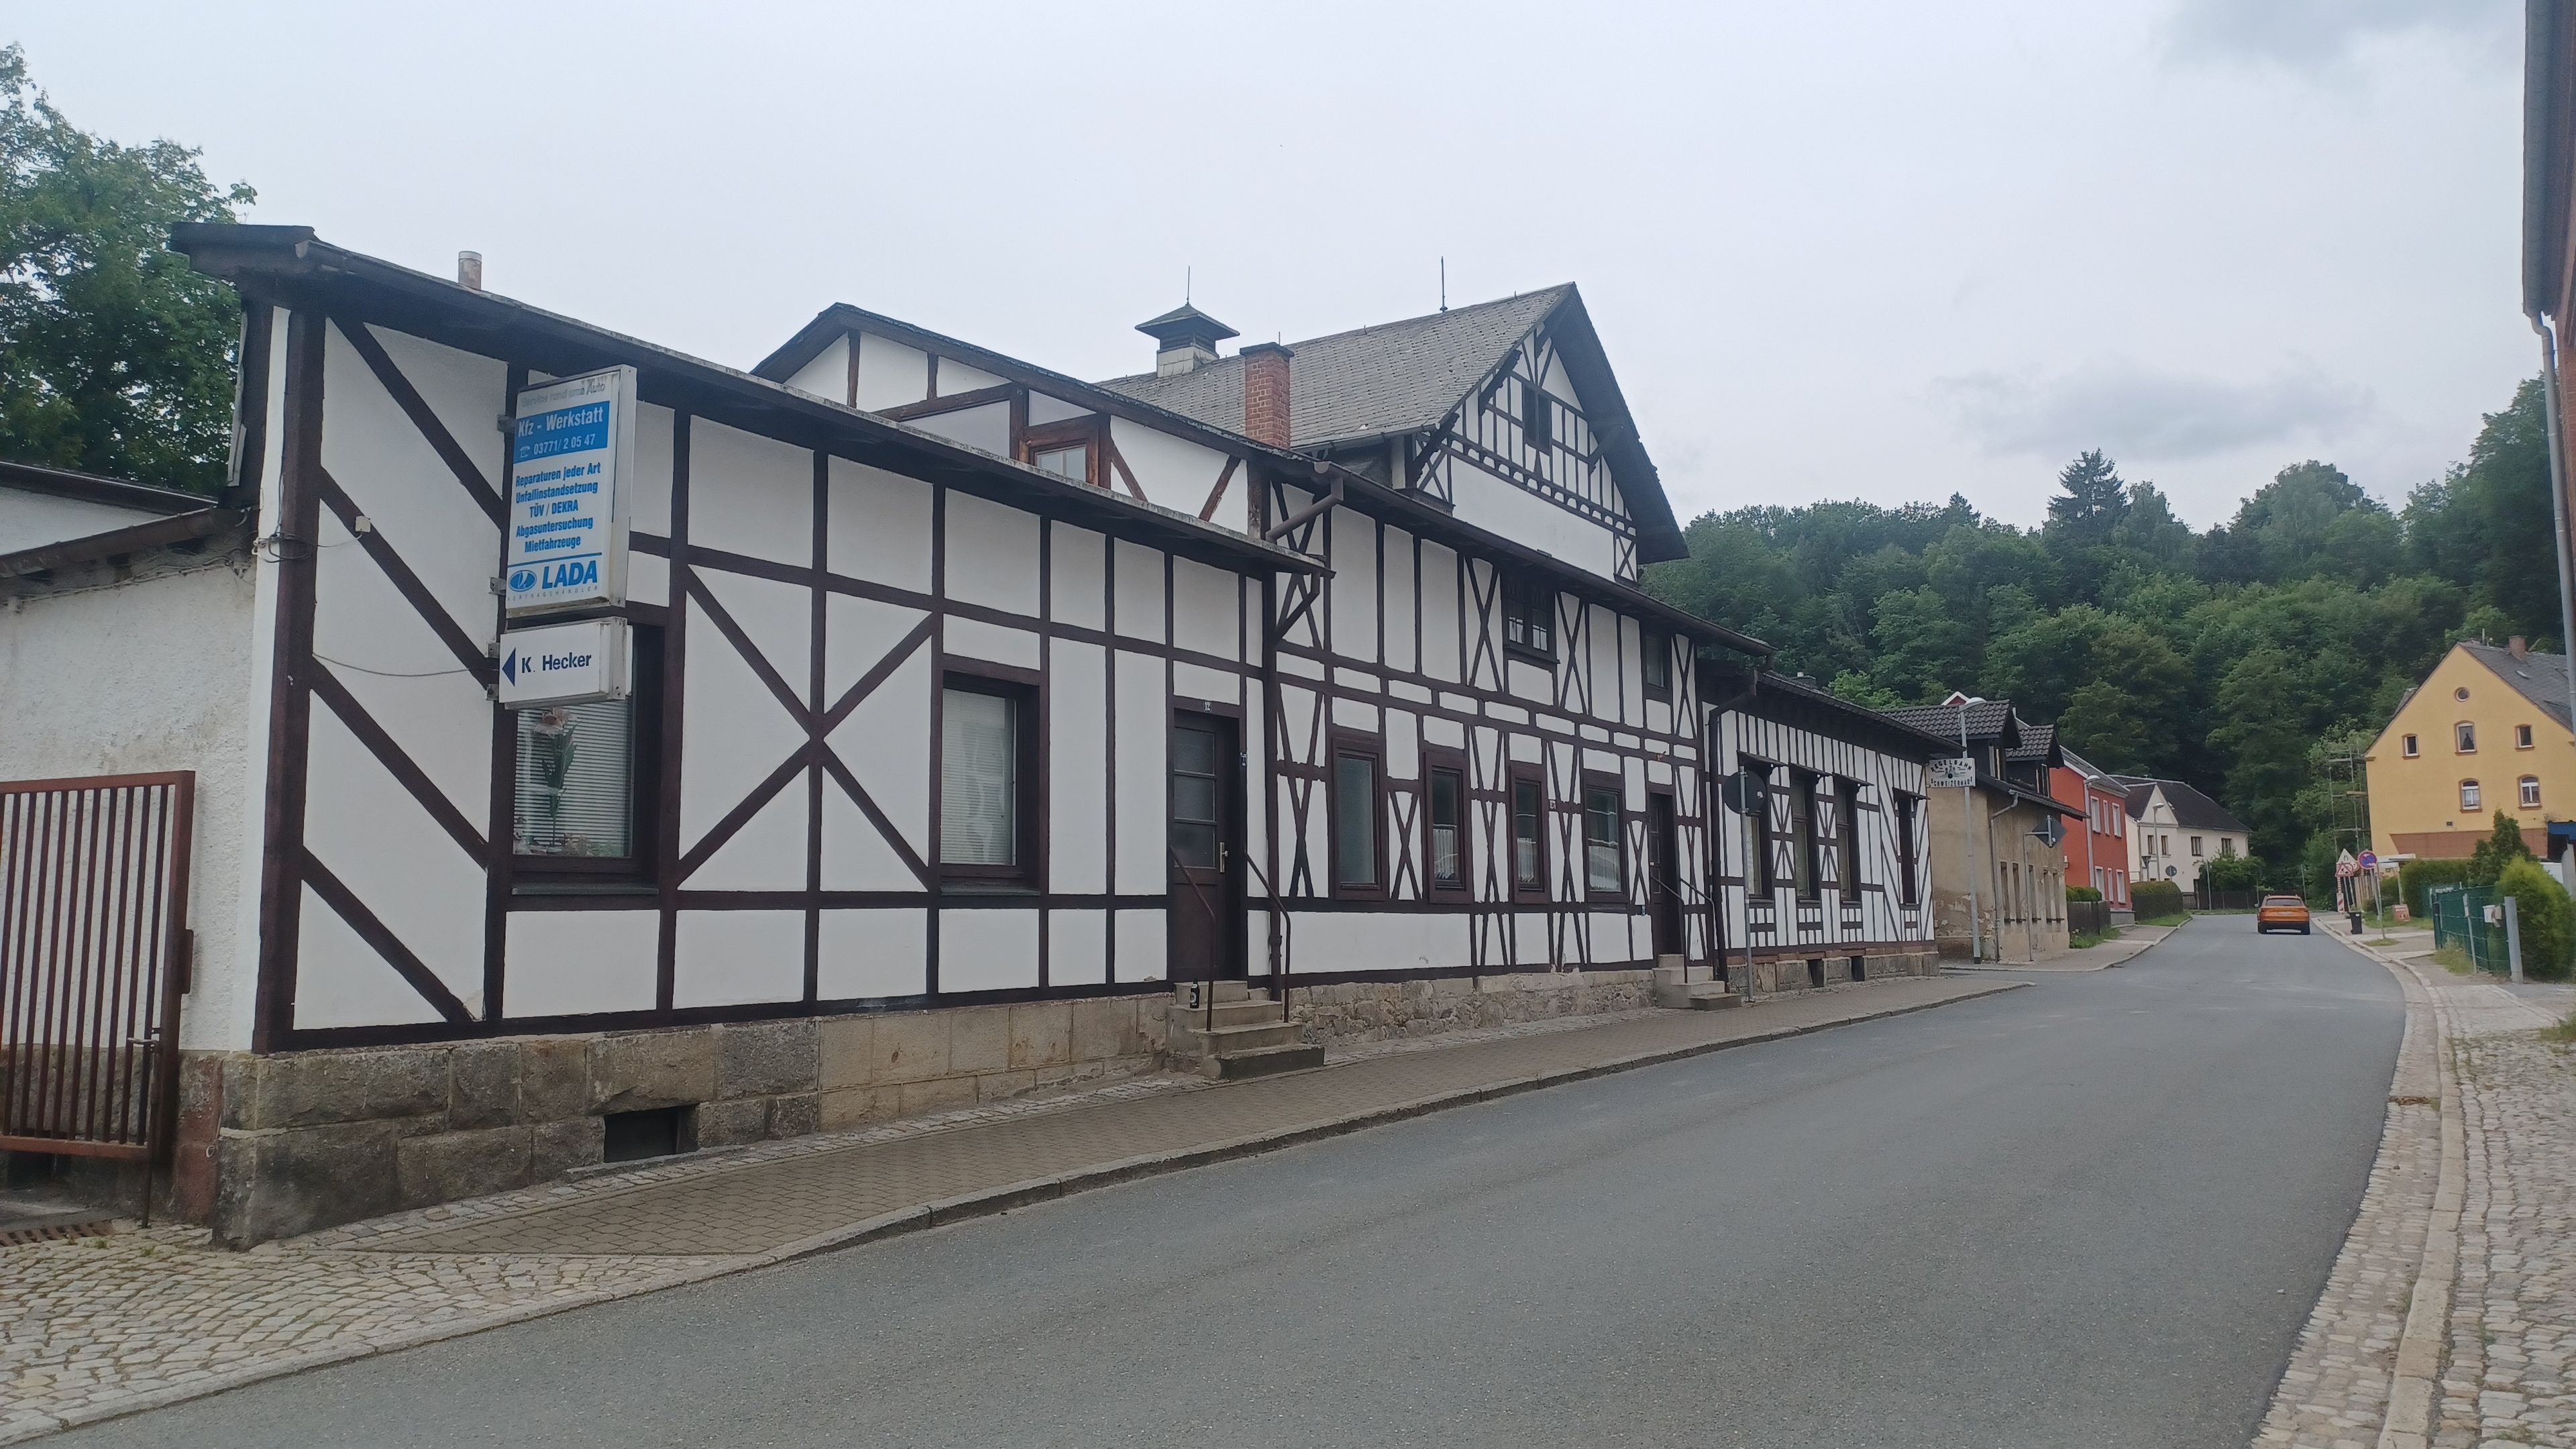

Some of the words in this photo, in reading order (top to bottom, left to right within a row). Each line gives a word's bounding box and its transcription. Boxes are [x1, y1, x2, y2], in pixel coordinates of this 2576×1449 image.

[518, 420, 535, 437] Kfz
[546, 407, 603, 431] Werkstatt
[533, 439, 561, 455] 03771/
[564, 437, 568, 450] 2
[571, 435, 582, 448] 05
[584, 433, 596, 445] 47
[516, 470, 561, 488] Reparaturen
[564, 465, 585, 480] jeder
[587, 462, 601, 475] Art
[516, 482, 598, 503] Unfallinstandsetzung
[529, 503, 545, 518] TÜV
[551, 500, 578, 515] DEKRA
[516, 517, 593, 538] Abgasuntersuchung
[525, 536, 581, 553] Mietfahrzeuge
[542, 560, 598, 589] LADA
[521, 656, 535, 674] K.
[542, 652, 592, 672] Hecker
[1204, 701, 1211, 711] 12
[1931, 759, 1972, 773] KEGELBAHN
